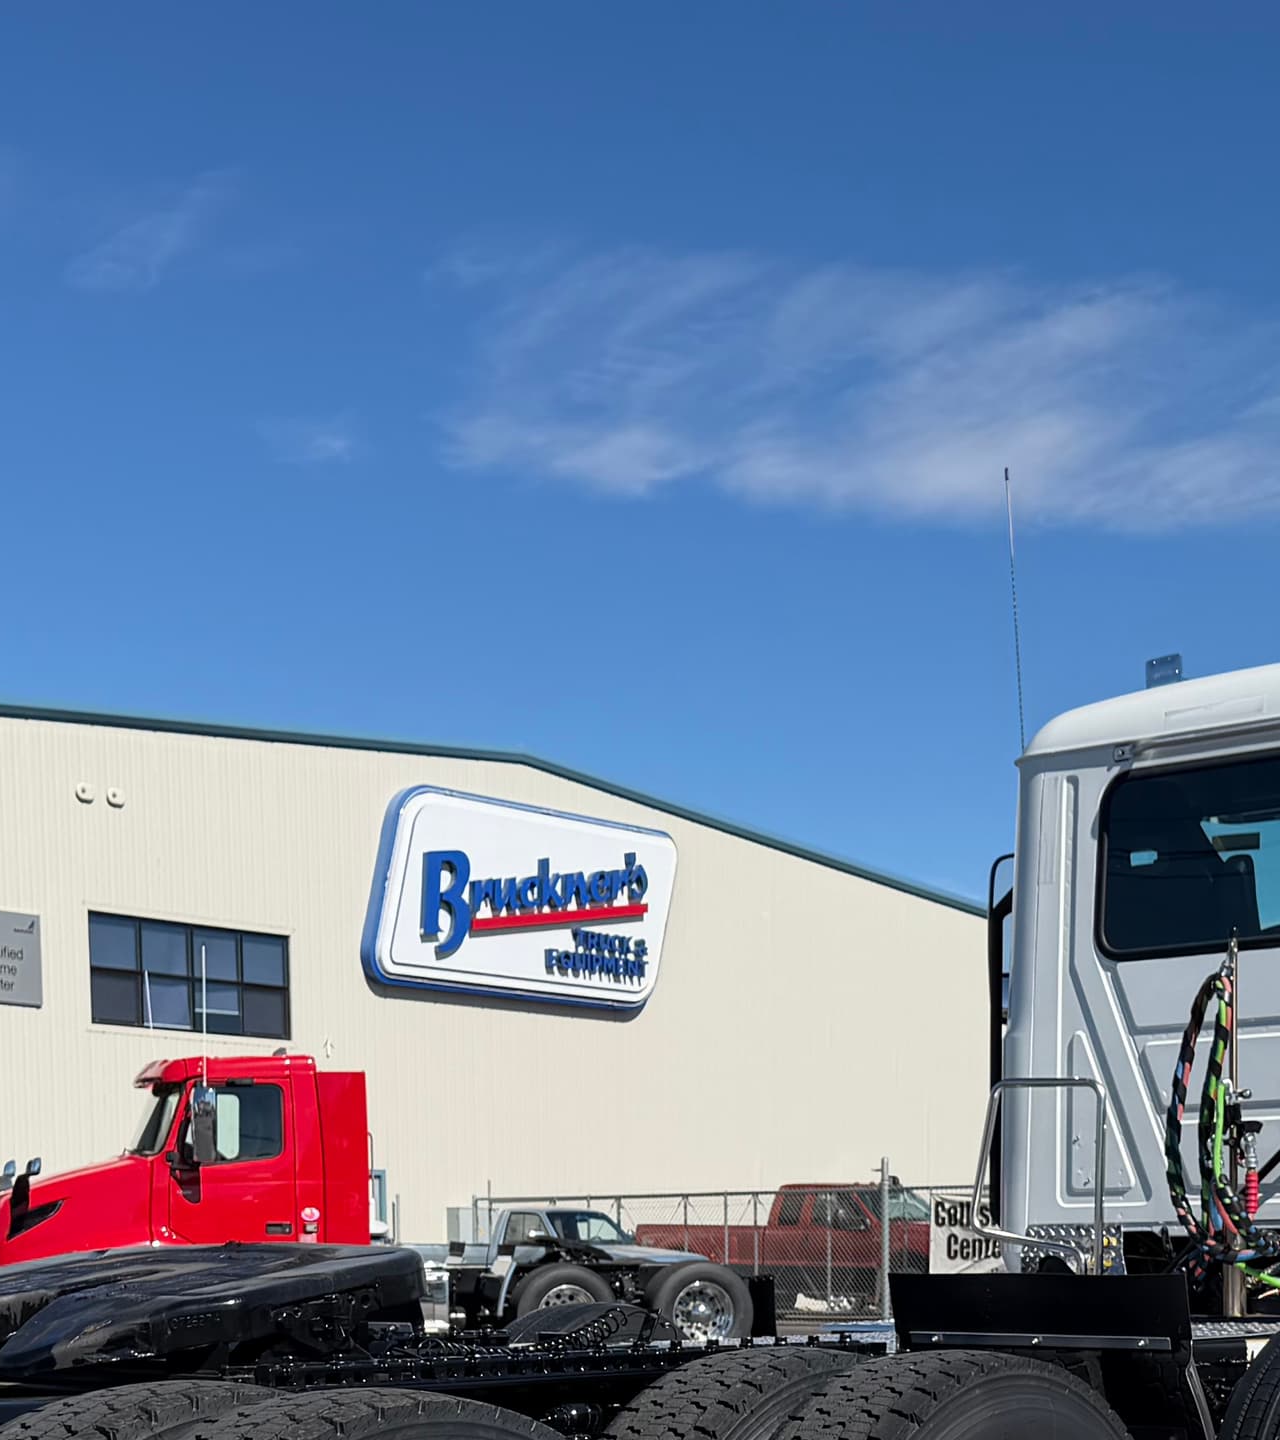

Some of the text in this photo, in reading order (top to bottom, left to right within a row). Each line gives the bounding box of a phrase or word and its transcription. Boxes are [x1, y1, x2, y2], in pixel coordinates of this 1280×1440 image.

[420, 850, 648, 961] Bruckner's
[571, 927, 632, 955] TRUCK
[544, 949, 649, 985] EQUIPMENT
[947, 1233, 1001, 1260] Cente
